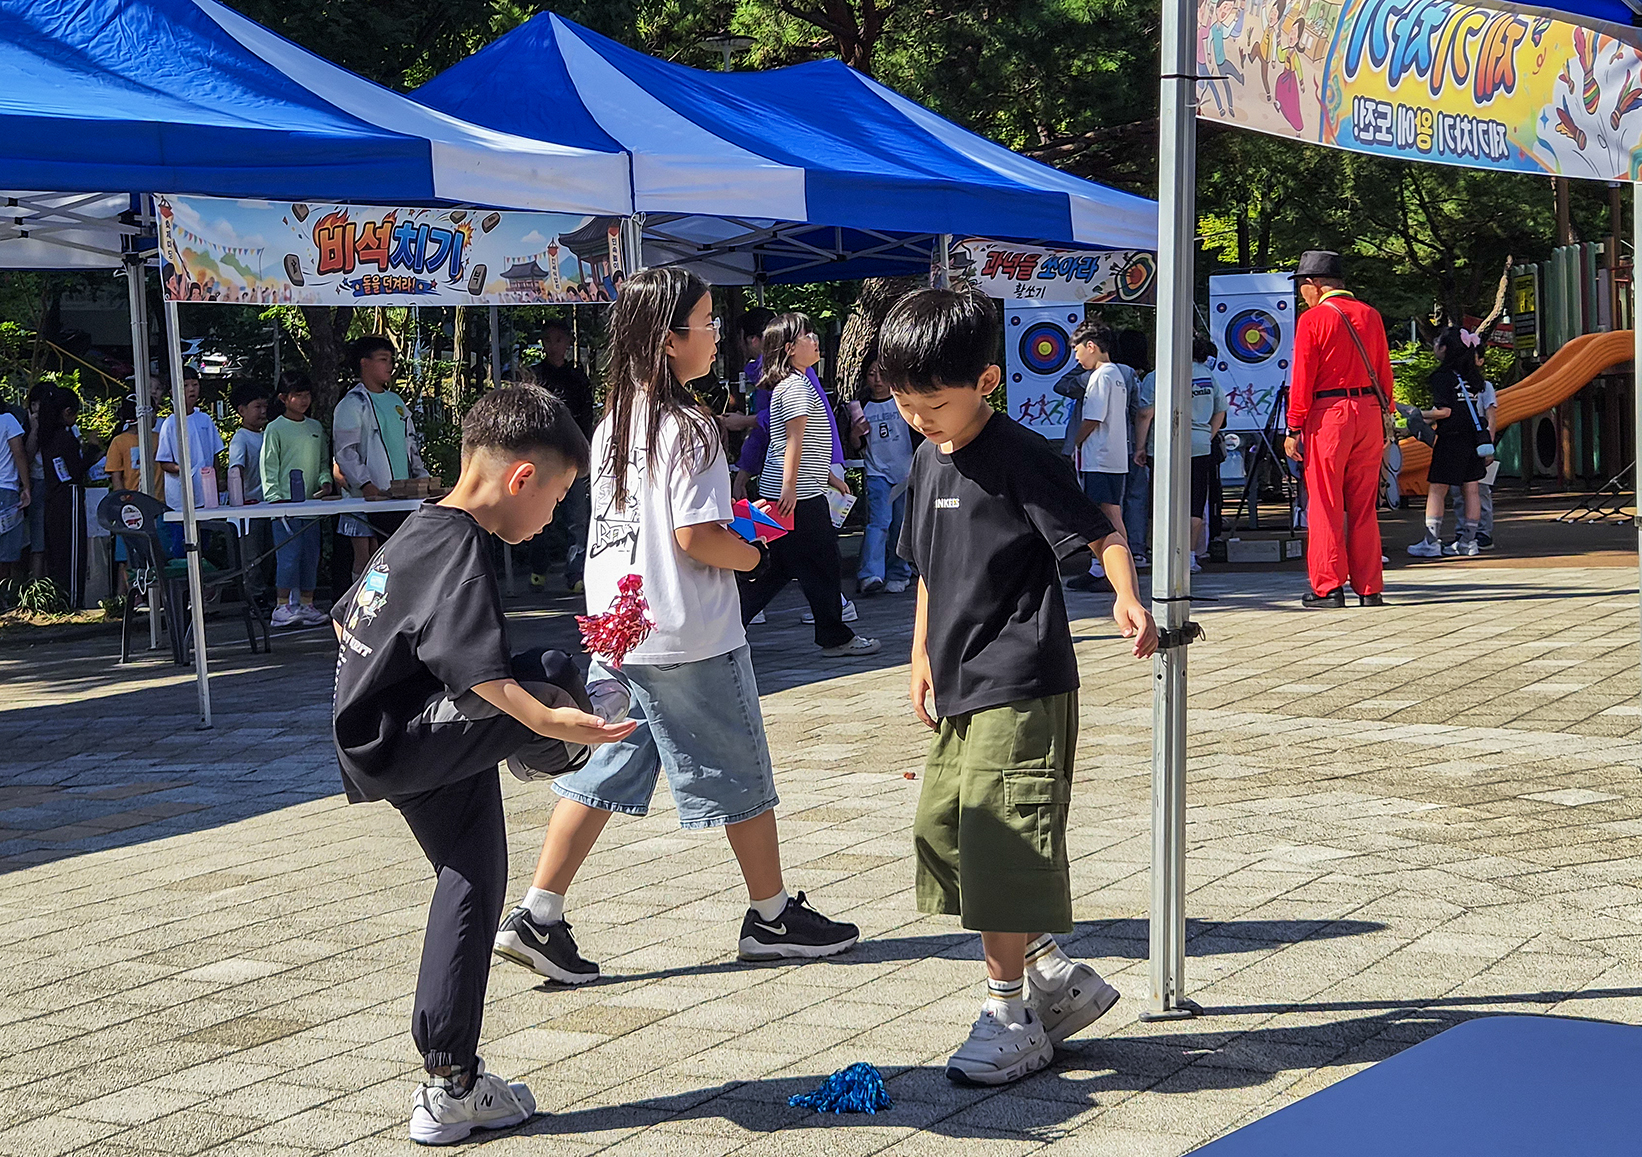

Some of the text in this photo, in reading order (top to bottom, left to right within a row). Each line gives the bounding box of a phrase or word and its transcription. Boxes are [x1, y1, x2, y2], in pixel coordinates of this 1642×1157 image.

[317, 220, 465, 279] 비석치기
[980, 250, 1101, 284] 과녁을 쏘아라
[362, 275, 381, 295] 돌을
[1013, 282, 1047, 299] 활쏘기
